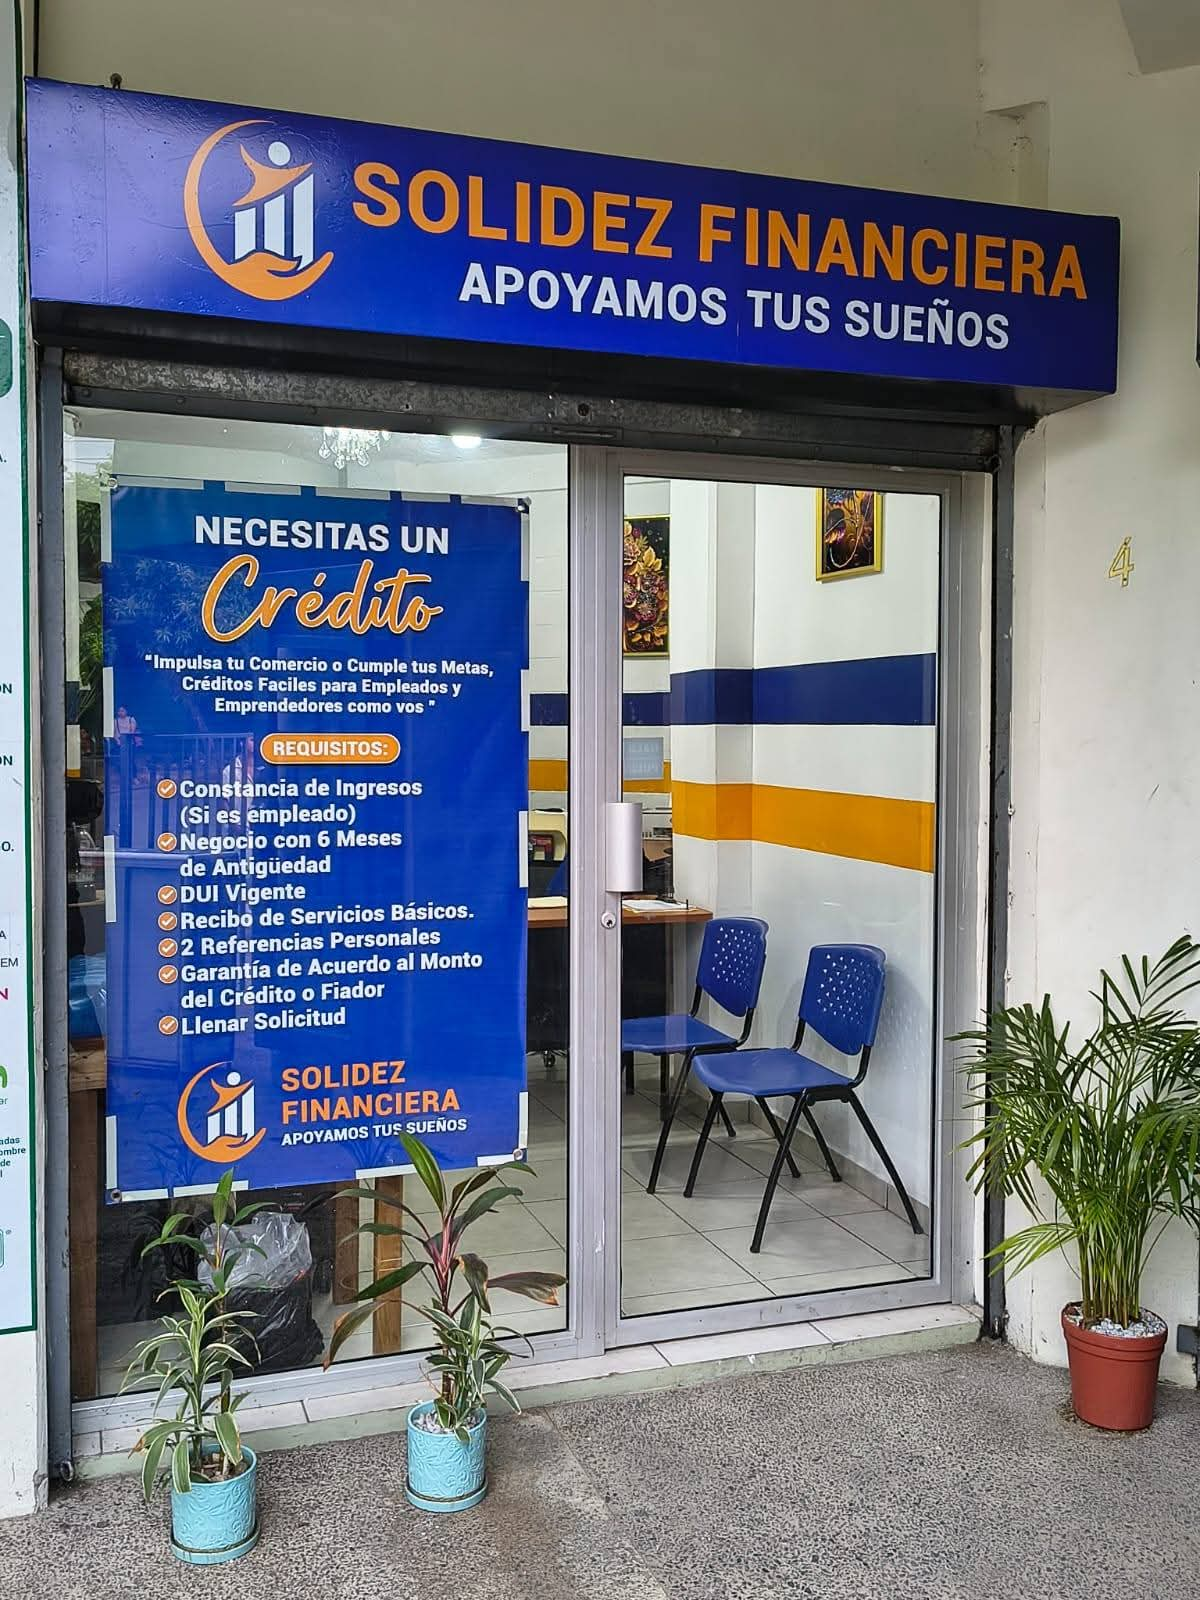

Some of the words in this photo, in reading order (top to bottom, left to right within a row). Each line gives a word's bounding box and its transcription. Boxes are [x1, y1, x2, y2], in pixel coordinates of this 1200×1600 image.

[352, 162, 673, 258] SOLIDEZ
[699, 203, 1088, 299] FINANCIERA
[459, 262, 727, 325] APOYAMOS
[747, 290, 830, 334] TUS
[845, 298, 1010, 350] SUEÑOS
[195, 515, 390, 553] NECESITAS
[401, 525, 450, 555] UN
[1108, 536, 1135, 587] 4
[201, 553, 444, 642] Crédito
[226, 656, 245, 671] tu
[249, 656, 328, 672] Comercio
[332, 660, 343, 672] o
[347, 658, 407, 678] Cumple
[411, 660, 437, 674] tus
[441, 660, 494, 678] Metas,
[182, 675, 253, 692] Créditos
[258, 677, 317, 693] Faciles
[321, 681, 357, 696] para
[361, 679, 449, 696] Empleados
[452, 684, 462, 697] y
[214, 698, 343, 716] Emprendedores
[347, 701, 392, 715] como
[396, 702, 425, 715] vos
[272, 740, 389, 758] REQUISITOS:
[180, 779, 299, 798] Constancia
[304, 778, 330, 797] de
[336, 779, 423, 800] Ingresos
[180, 805, 210, 828] (Si
[216, 809, 241, 824] es
[247, 803, 356, 827] empleado)
[180, 831, 268, 854] Negocio
[273, 833, 311, 849] con
[317, 831, 331, 848] 6
[336, 830, 403, 847] Meses
[180, 858, 206, 877] de
[212, 854, 332, 879] Antigüedad
[180, 884, 218, 903] DUI
[225, 883, 306, 904] Vigente
[181, 910, 253, 931] Recibo
[259, 907, 285, 926] de
[291, 904, 385, 926] Servicios
[391, 901, 475, 922] Básicos.
[181, 938, 194, 957] 2
[201, 932, 324, 956] Referencias
[330, 927, 441, 950] Personales
[181, 960, 271, 983] Garantía
[277, 958, 302, 977] de
[307, 955, 391, 976] Acuerdo
[396, 953, 415, 971] al
[420, 951, 483, 970] Monto
[181, 989, 214, 1009] del
[220, 985, 296, 1007] Crédito
[302, 988, 315, 1002] o
[321, 981, 385, 1001] Fiador
[181, 1014, 249, 1036] Llenar
[254, 1007, 346, 1031] Solicitud
[281, 1060, 406, 1092] SOLIDEZ
[281, 1088, 460, 1125] FINANCIERA
[281, 1126, 369, 1147] APOYAMOS
[372, 1123, 402, 1137] TUS
[406, 1116, 468, 1135] SUEÑOS
